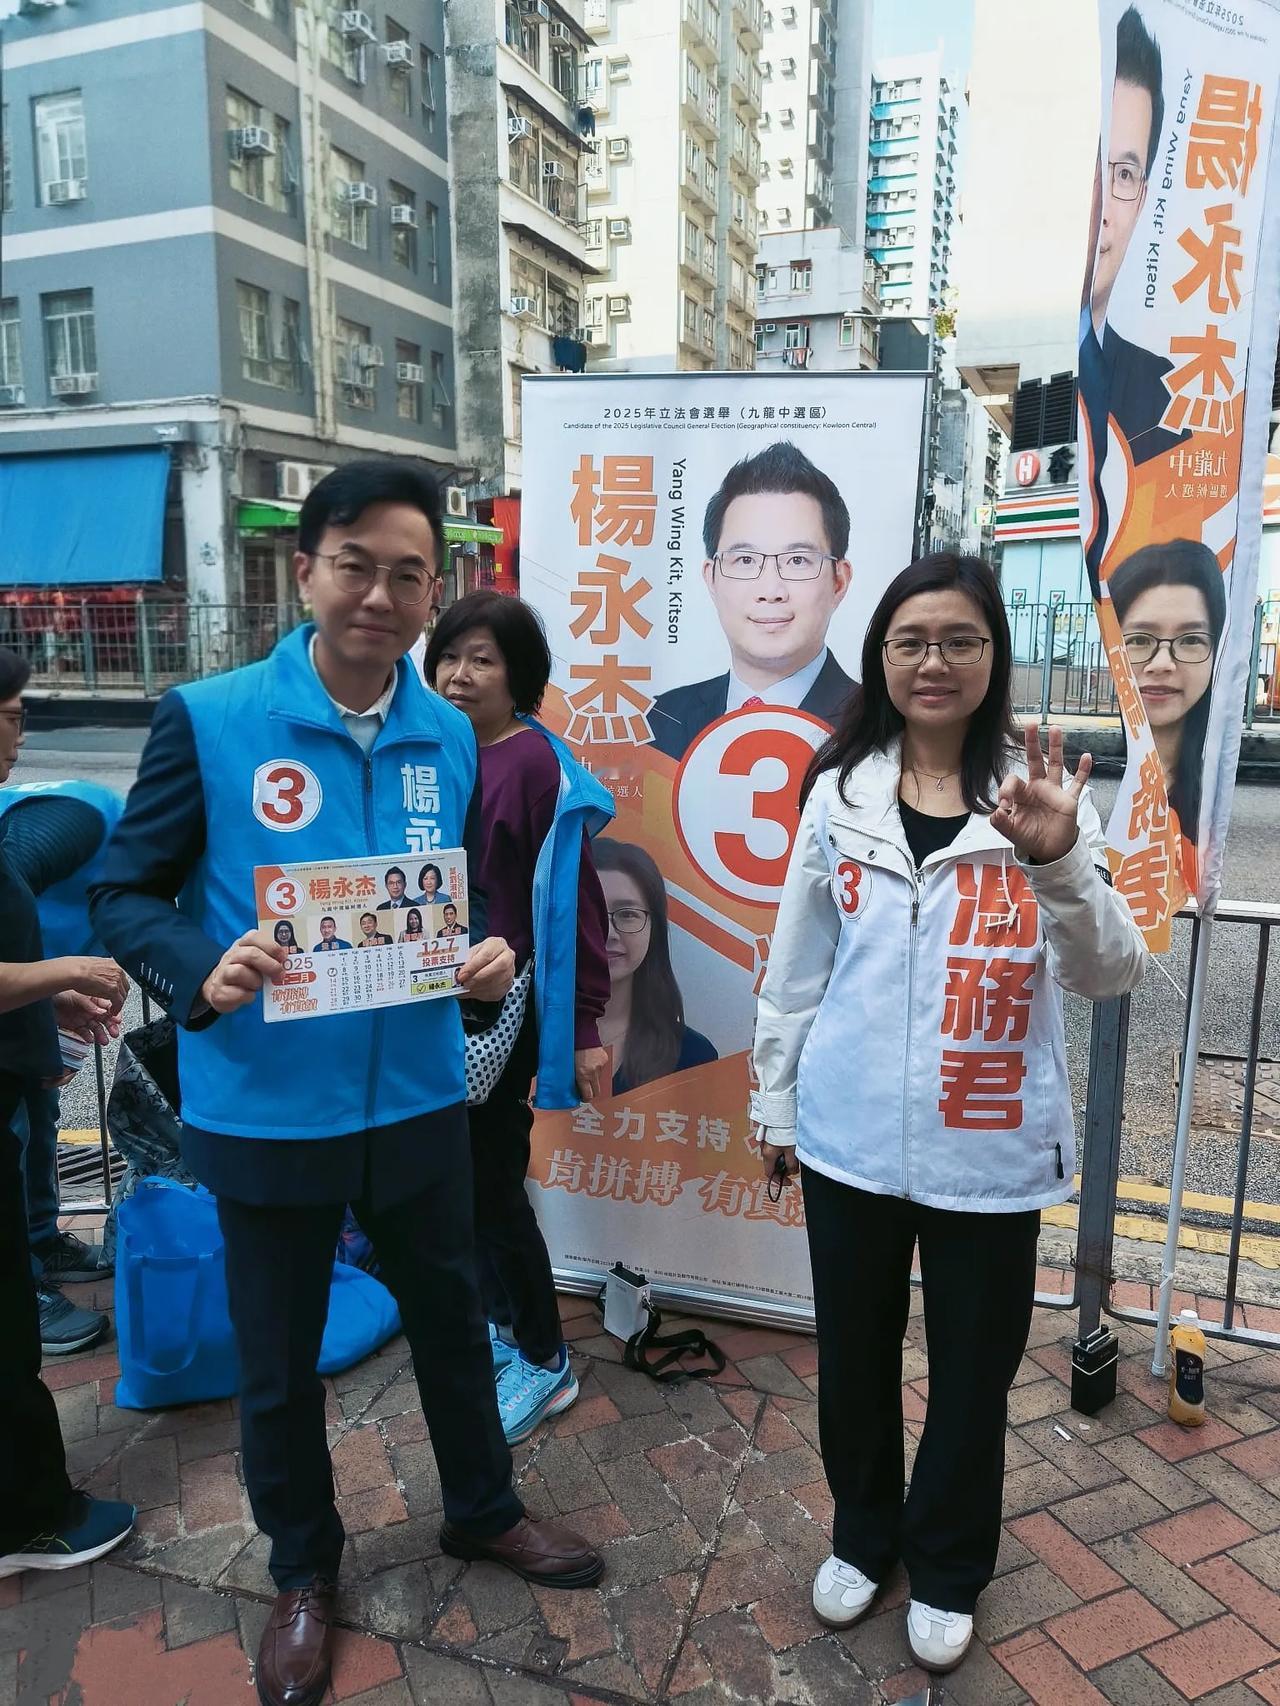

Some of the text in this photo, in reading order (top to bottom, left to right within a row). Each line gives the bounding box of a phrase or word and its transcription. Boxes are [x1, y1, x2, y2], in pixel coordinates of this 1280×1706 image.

[667, 458, 687, 644] Yang Wing Kit, Kitson
[564, 453, 658, 747] 楊永杰
[262, 767, 306, 824] 3
[714, 729, 817, 887] 3
[276, 882, 297, 910] 3
[309, 875, 376, 901] 楊永杰
[838, 861, 863, 914] 3
[282, 957, 313, 970] 025
[412, 975, 418, 983] 3
[938, 863, 1040, 1131] 馮務君
[571, 1102, 731, 1152] 全力支持
[544, 1149, 683, 1204] 肯拼搏
